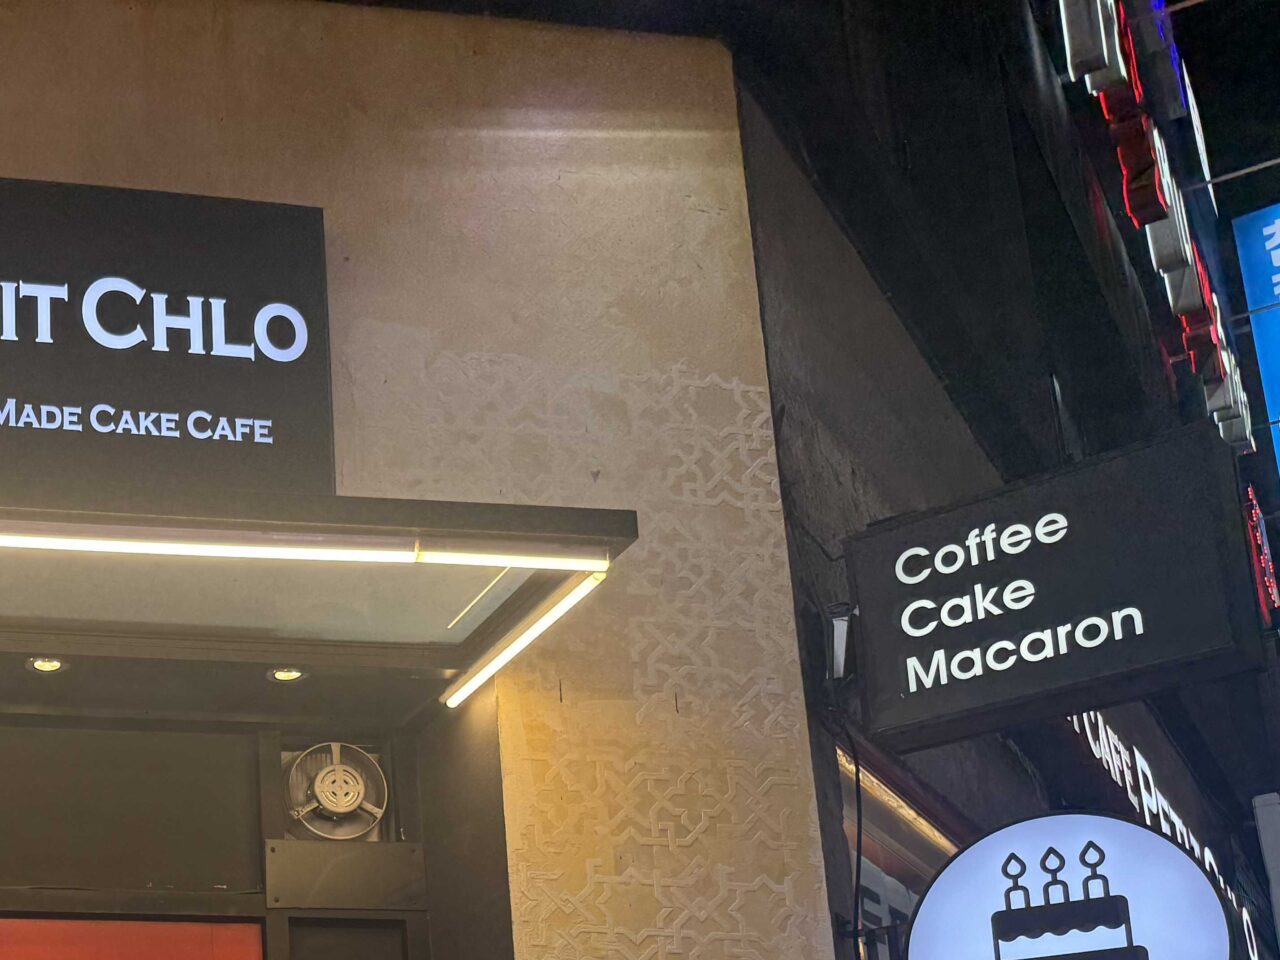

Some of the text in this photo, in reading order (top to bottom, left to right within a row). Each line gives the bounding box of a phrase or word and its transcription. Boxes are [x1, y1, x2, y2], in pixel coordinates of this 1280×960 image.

[894, 511, 1069, 586] Coffee
[900, 578, 1036, 638] Cake
[905, 605, 1145, 694] Macaron
